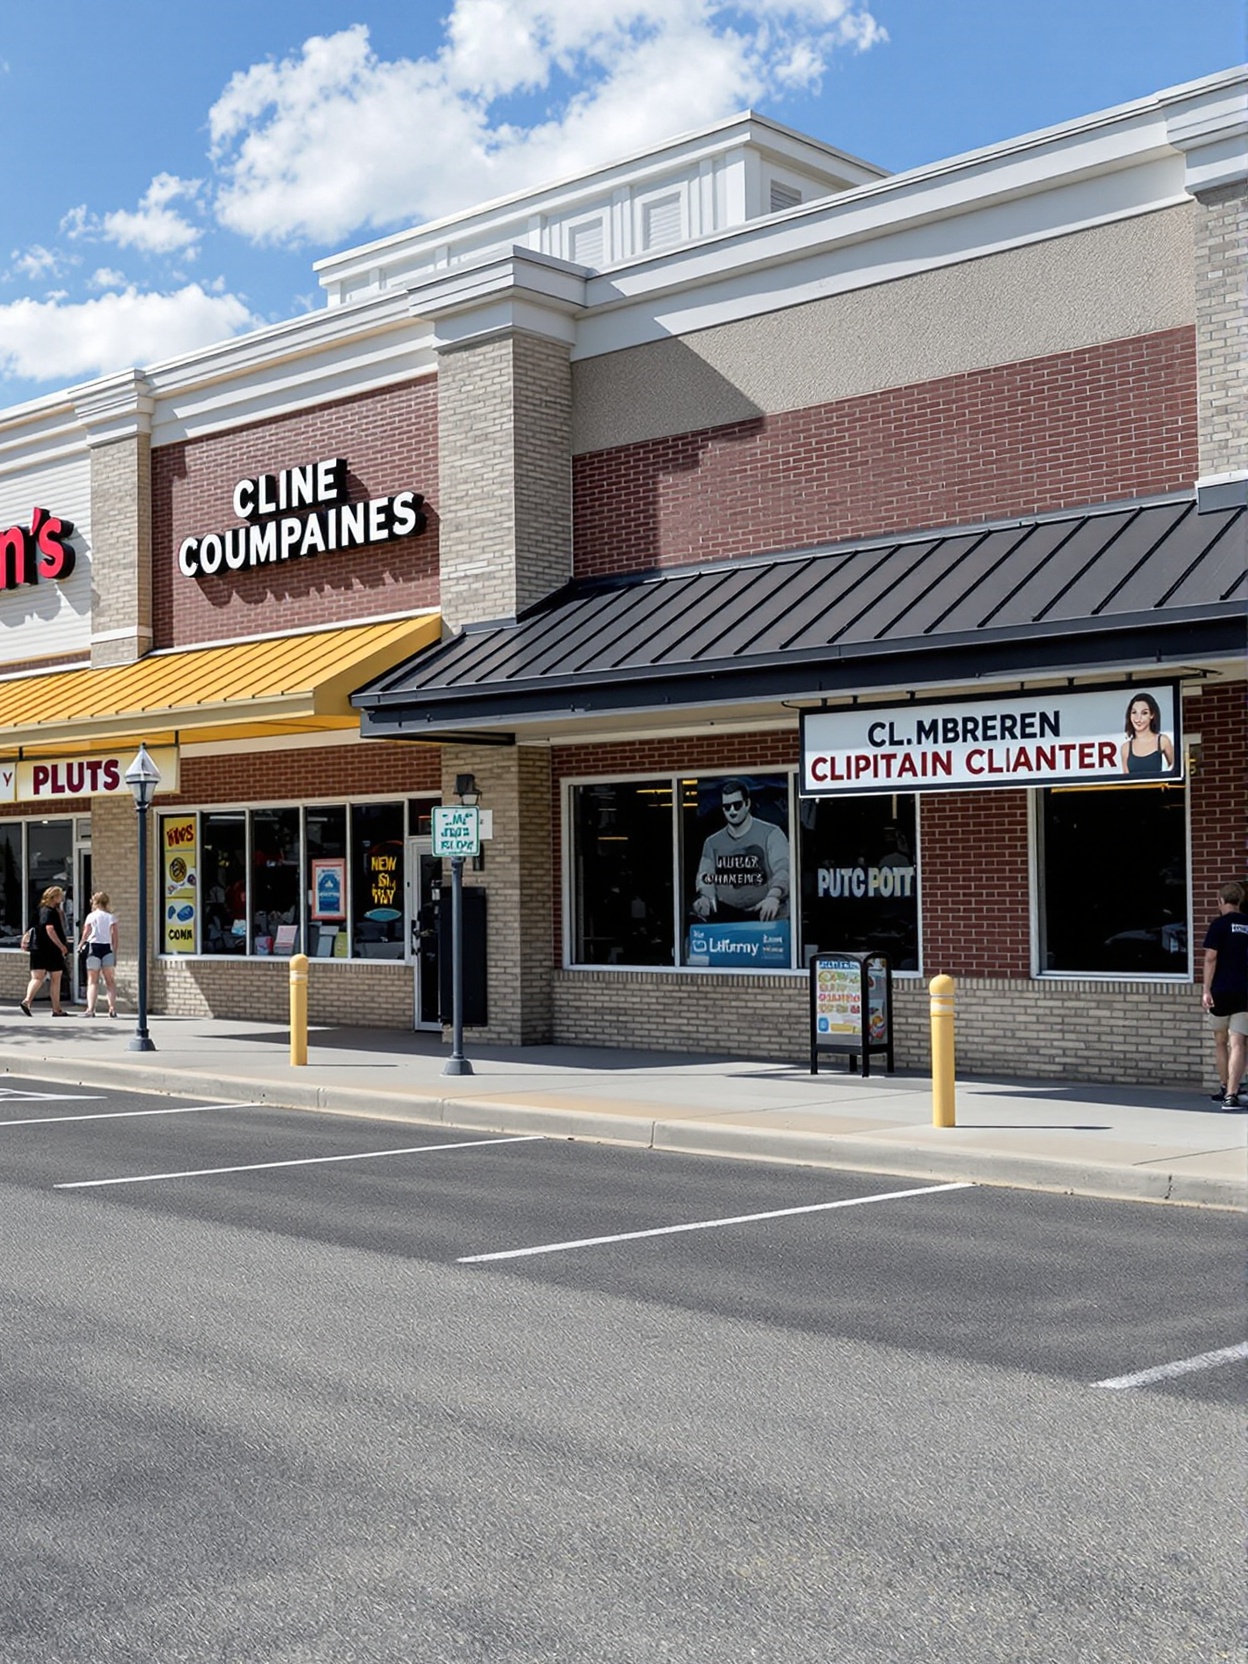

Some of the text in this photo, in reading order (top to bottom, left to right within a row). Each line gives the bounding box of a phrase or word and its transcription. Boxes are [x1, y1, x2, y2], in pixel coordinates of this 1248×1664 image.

[233, 458, 338, 518] CLINE
[178, 491, 417, 577] COUMPAINES
[33, 759, 120, 795] PLUTS
[810, 750, 952, 782] CLIPITAIN
